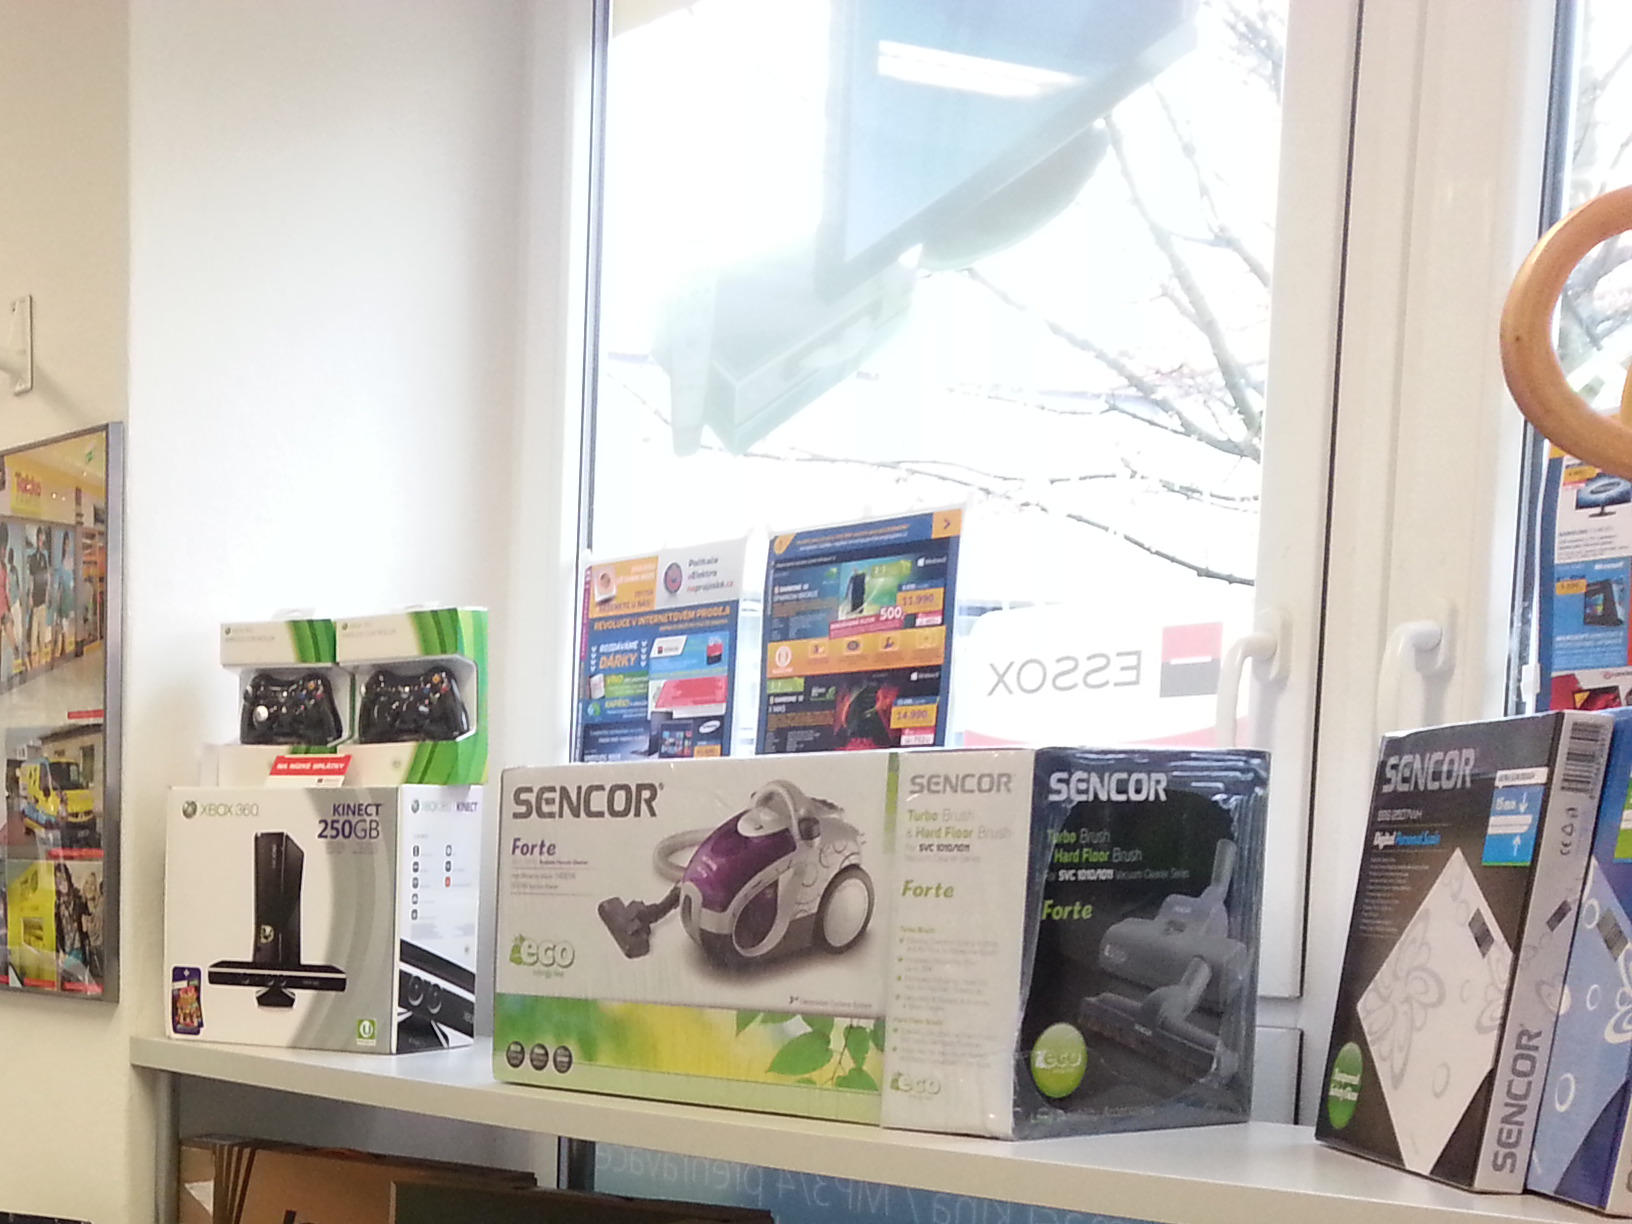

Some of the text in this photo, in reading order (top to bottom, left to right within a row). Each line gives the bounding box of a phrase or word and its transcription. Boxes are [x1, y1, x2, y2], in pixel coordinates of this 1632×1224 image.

[599, 653, 638, 669] DÁRKY
[1381, 747, 1476, 794] SENCOR
[909, 773, 1012, 795] SENCOR
[1047, 770, 1168, 803] SENCOR
[199, 803, 259, 817] XBOX 360
[332, 802, 383, 817] KINECT
[456, 801, 478, 813] KINECT
[512, 783, 660, 820] SENCOR
[907, 808, 974, 822] Turbo Brush
[317, 819, 381, 840] 250GB
[915, 827, 943, 839] Hard
[945, 827, 973, 839] Floor
[976, 826, 1012, 839] Brush
[1047, 829, 1111, 844] Turbo Brush
[511, 838, 557, 857] Forte
[1054, 847, 1143, 863] Hard Floor Brush
[1058, 869, 1076, 882] SVC
[901, 879, 955, 899] Forte
[1041, 900, 1093, 921] Forte
[520, 939, 575, 969] eco
[1491, 1027, 1543, 1175] SENCOR
